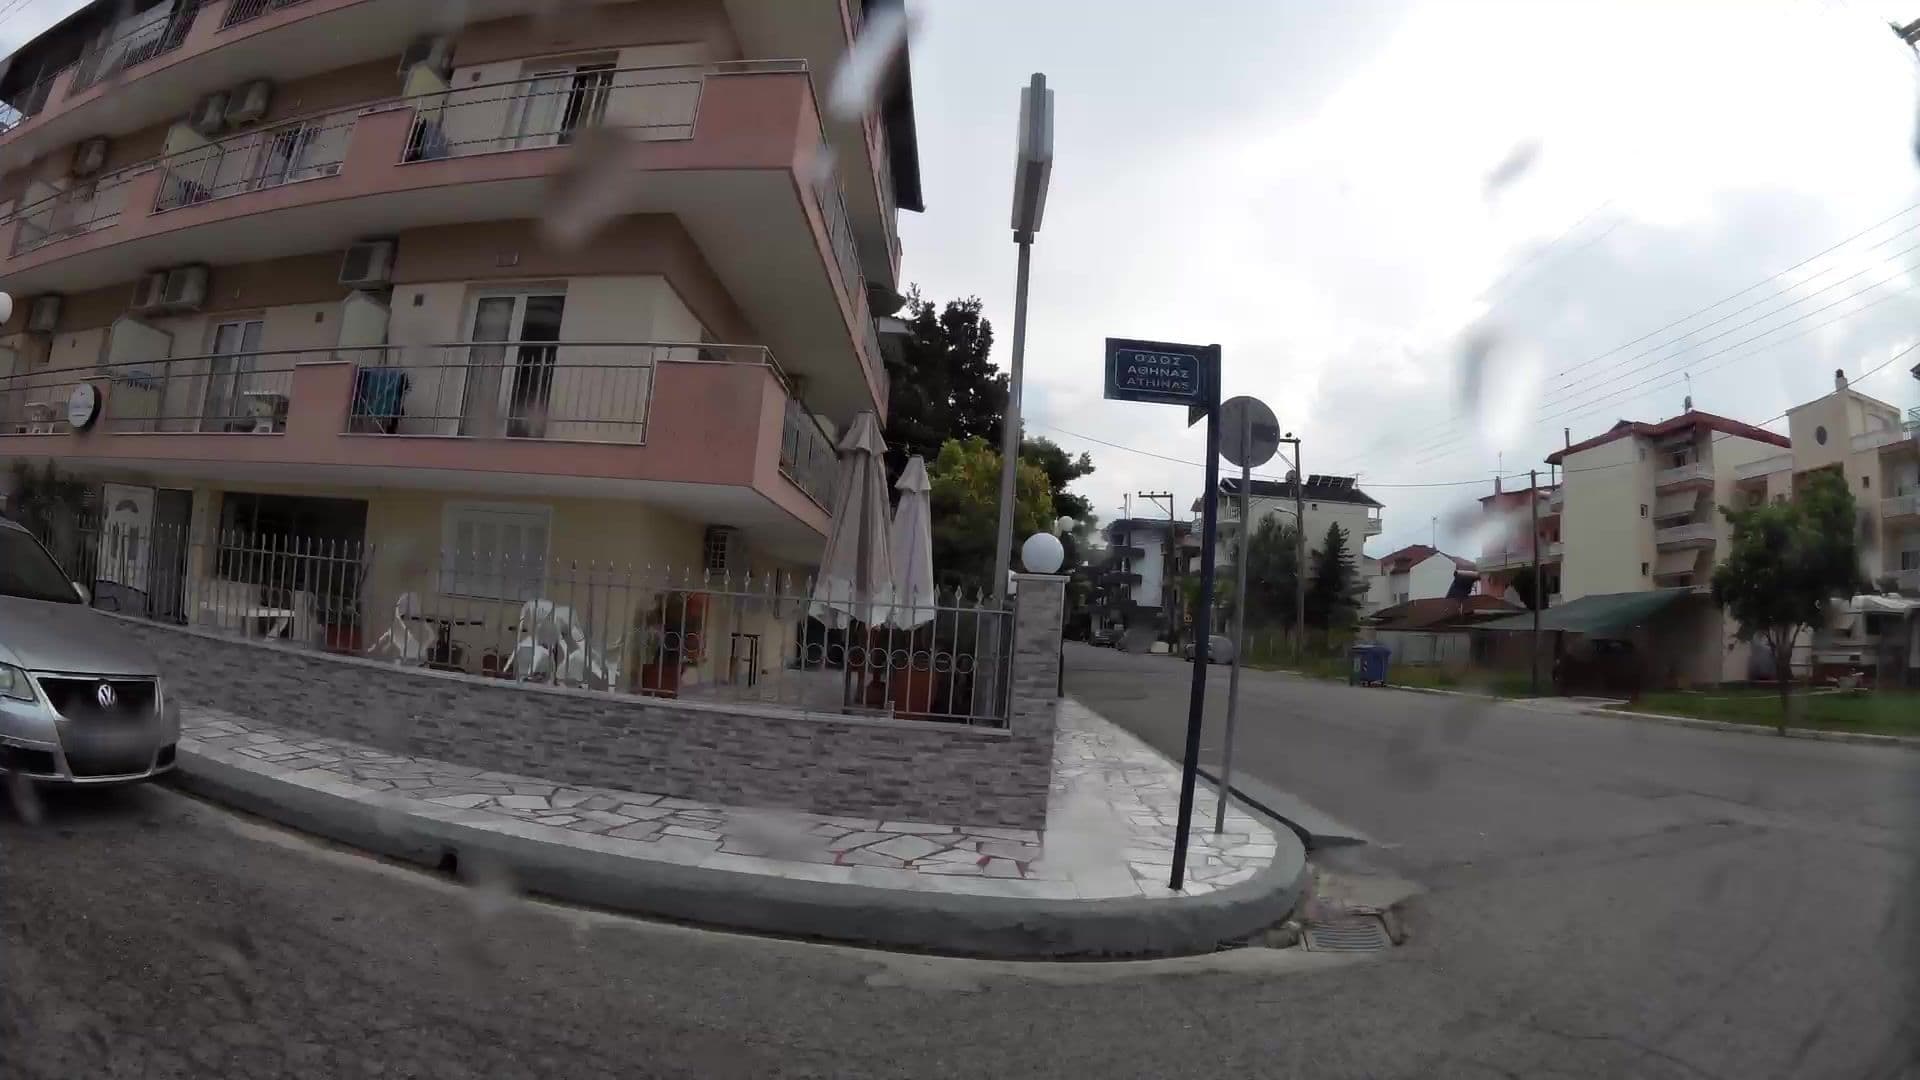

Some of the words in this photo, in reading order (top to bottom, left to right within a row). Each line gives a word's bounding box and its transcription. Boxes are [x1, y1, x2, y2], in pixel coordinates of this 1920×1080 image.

[1135, 354, 1181, 366] ΟΔΟΣ
[1128, 365, 1189, 378] ΑΘΗΝΑΣ
[1127, 377, 1189, 390] ATHINAS
